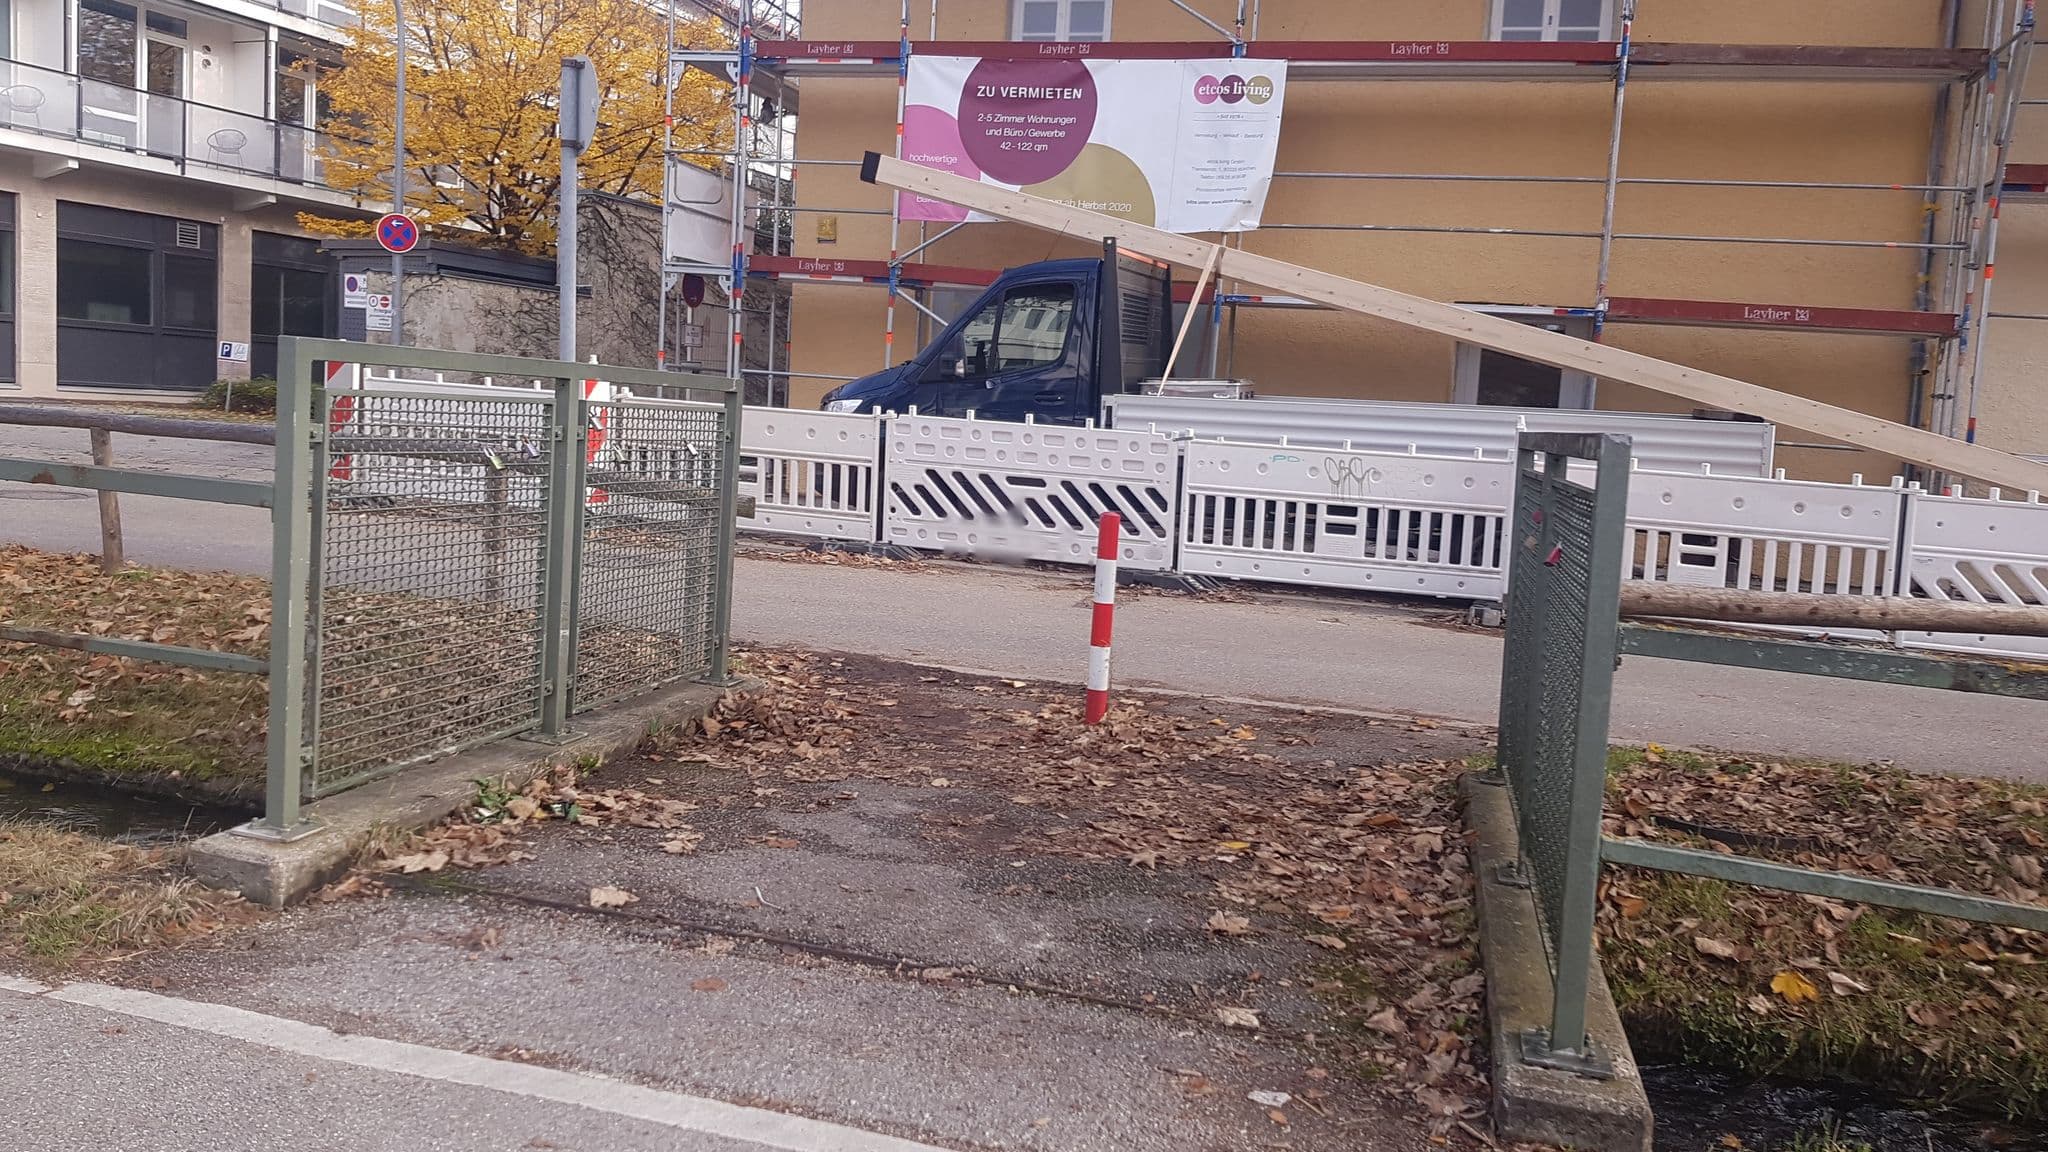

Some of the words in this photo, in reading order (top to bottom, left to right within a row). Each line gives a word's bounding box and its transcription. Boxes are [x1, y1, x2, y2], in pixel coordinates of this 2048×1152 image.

[807, 43, 840, 55] Layher
[1039, 43, 1075, 55] Layher
[1390, 42, 1432, 55] Layher
[976, 85, 995, 97] ZU
[1000, 86, 1083, 100] VERMIETEN
[1198, 84, 1230, 95] etcos
[1232, 81, 1271, 98] living
[977, 113, 993, 122] 2-5
[993, 113, 1025, 123] Zimmer
[1027, 114, 1077, 126] Wohnungen
[985, 128, 1002, 137] und
[1034, 143, 1049, 153] qm
[909, 153, 958, 166] hochwertige
[1077, 199, 1106, 211] Herbst
[1108, 202, 1132, 213] 2020
[798, 258, 831, 272] Layher
